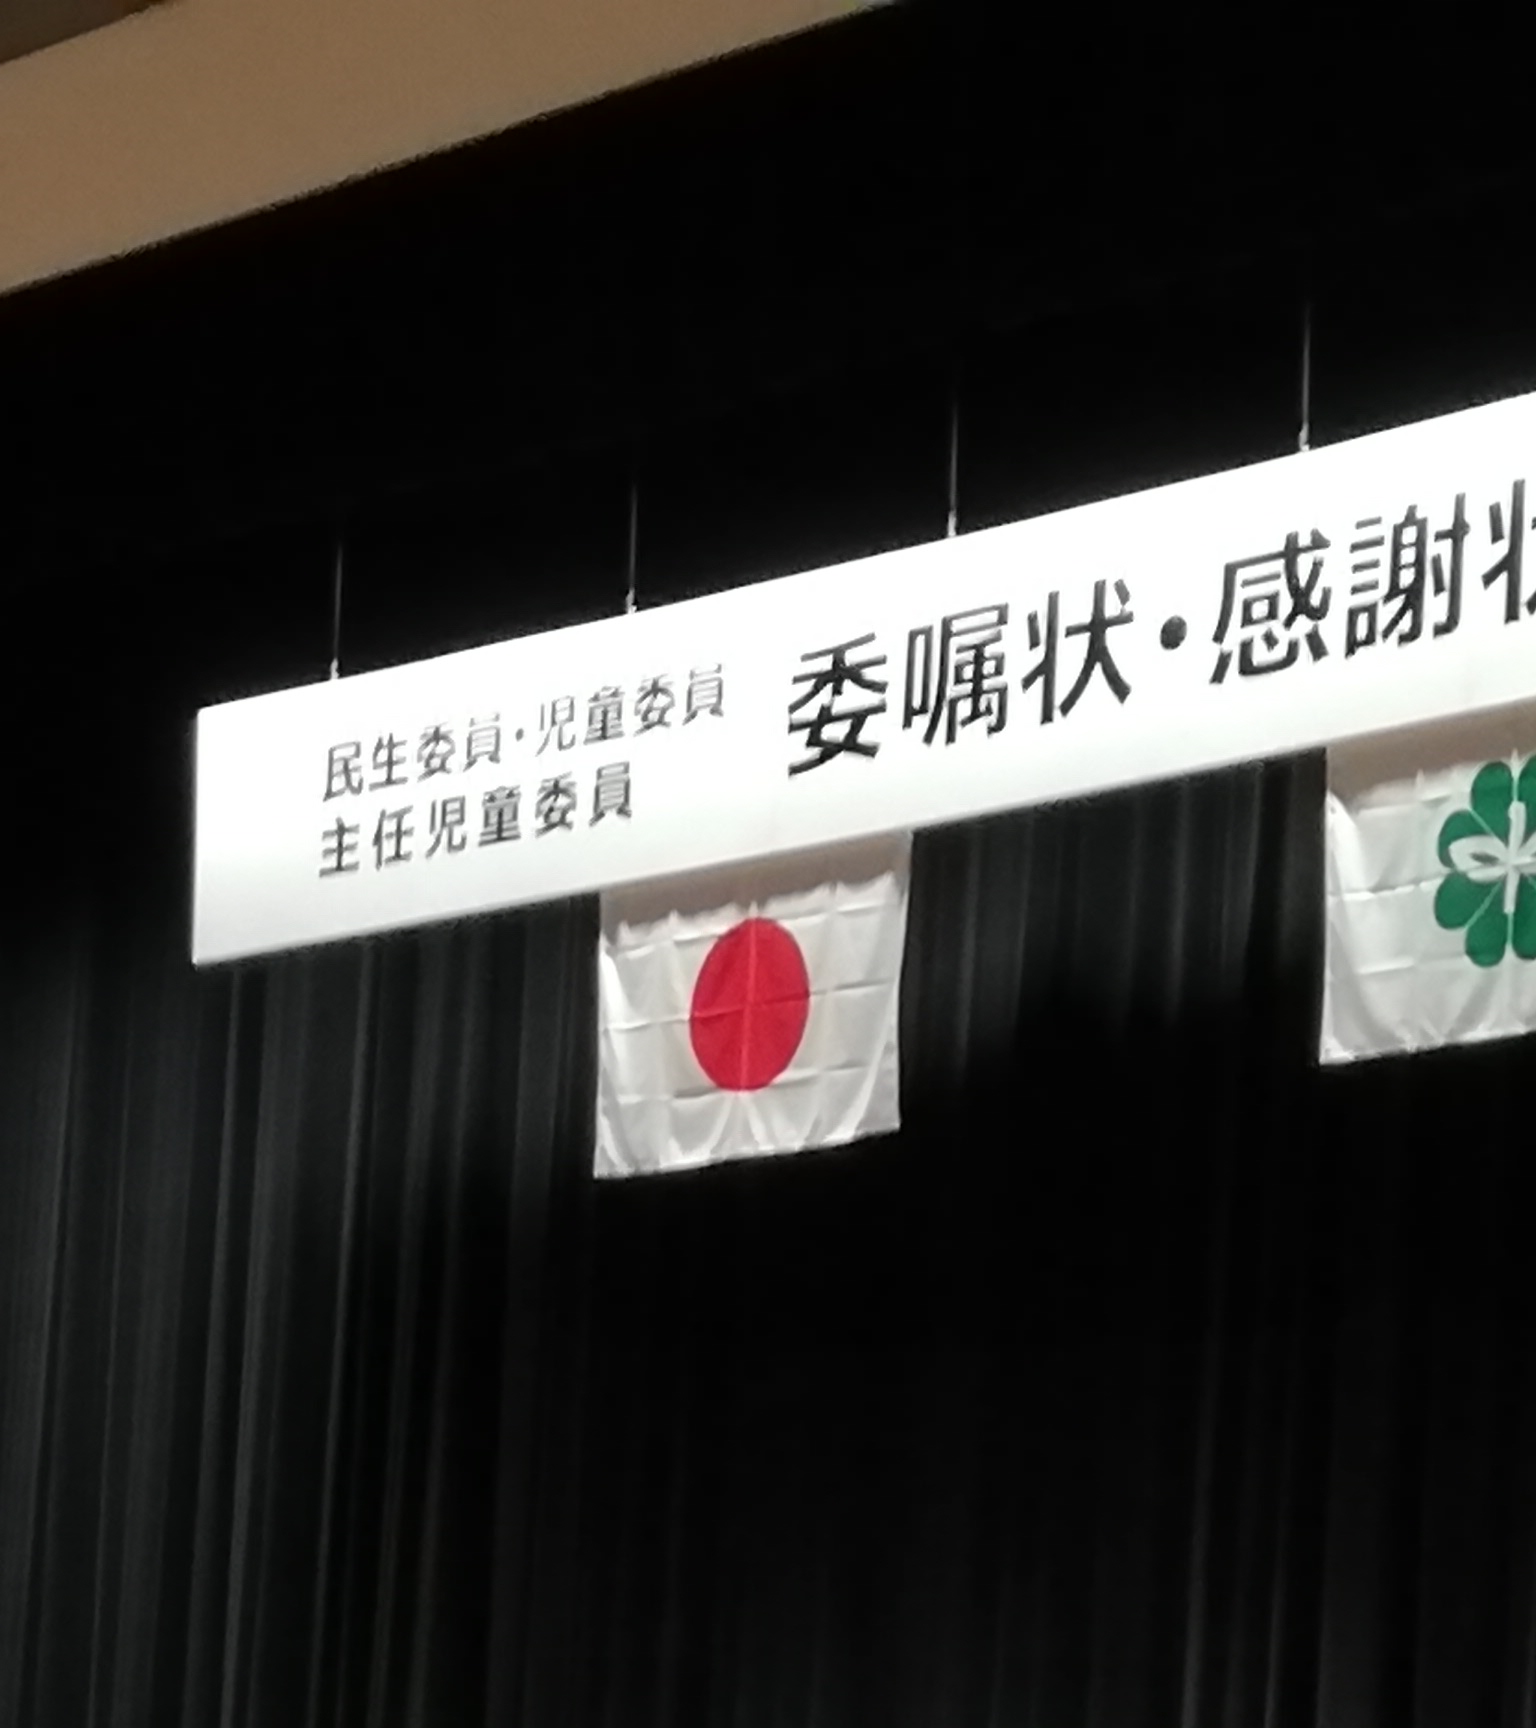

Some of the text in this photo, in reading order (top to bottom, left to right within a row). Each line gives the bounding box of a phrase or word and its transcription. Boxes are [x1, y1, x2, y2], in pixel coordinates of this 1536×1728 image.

[321, 662, 725, 803] 民生委員・児童委員
[317, 760, 633, 879] 主任児童委員
